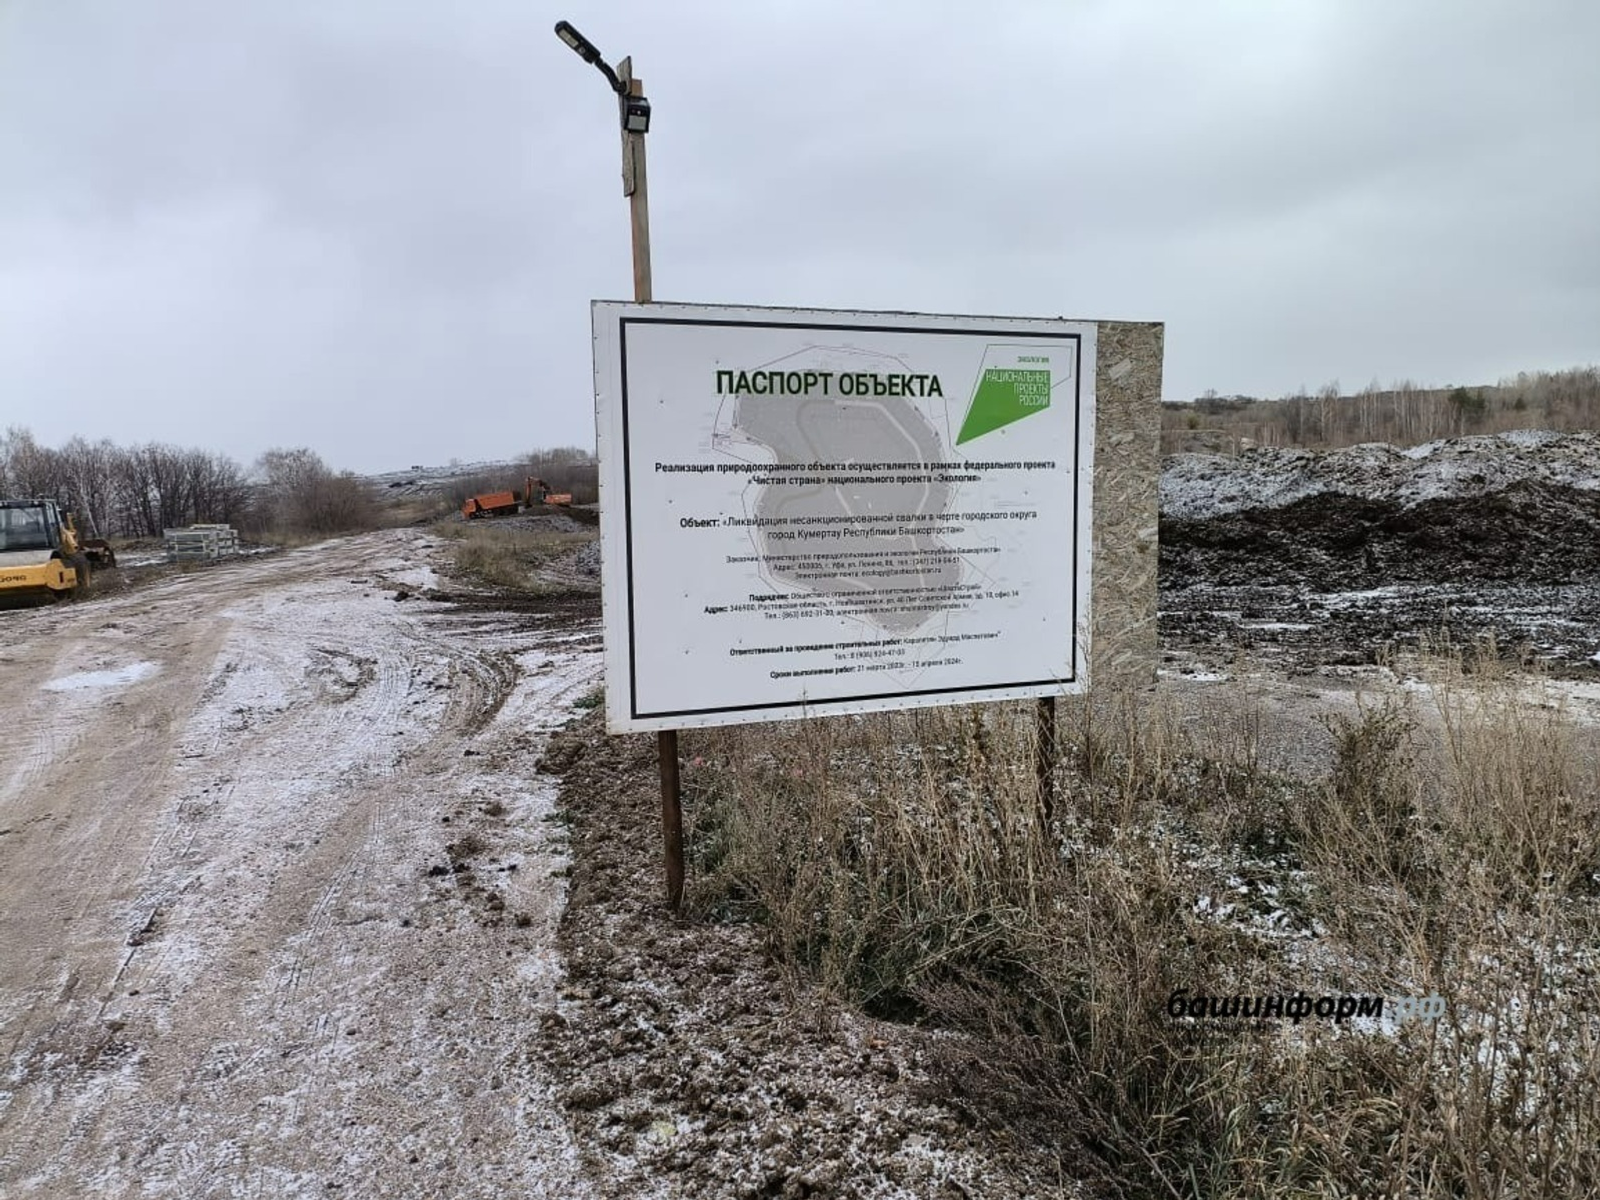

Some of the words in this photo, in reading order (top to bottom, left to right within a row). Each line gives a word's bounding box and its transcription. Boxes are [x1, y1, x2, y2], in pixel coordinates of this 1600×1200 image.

[716, 370, 833, 395] ПАСПОРТ
[839, 373, 943, 397] ОБЪЕКТА
[986, 371, 1048, 382] НАЦИОНАЛЬНЫЕ
[1014, 383, 1048, 394] ПРОЕКТЫ
[1020, 395, 1048, 405] РОССИИ
[655, 462, 714, 474] Реализация
[717, 463, 805, 475] природоохранного
[807, 461, 846, 471] объекта
[848, 462, 921, 472] осуществляется
[930, 463, 961, 472] рамках
[963, 460, 1022, 472] федерального
[1023, 462, 1055, 471] проекта
[748, 476, 787, 485] «Чистая
[788, 477, 825, 486] страна»
[828, 475, 895, 486] национального
[897, 476, 932, 485] проекта
[933, 473, 981, 483] «Экология»
[680, 517, 720, 528] Объект:
[722, 516, 788, 528] «Ликвидация
[790, 513, 894, 526] несанкционированной
[896, 513, 927, 522] свалки
[936, 513, 960, 523] черте
[961, 512, 1008, 522] городского
[1010, 511, 1037, 520] округа
[767, 532, 795, 541] город
[797, 530, 841, 541] Кумертау
[844, 527, 896, 539] Республики
[899, 526, 965, 537] Башкортостан»
